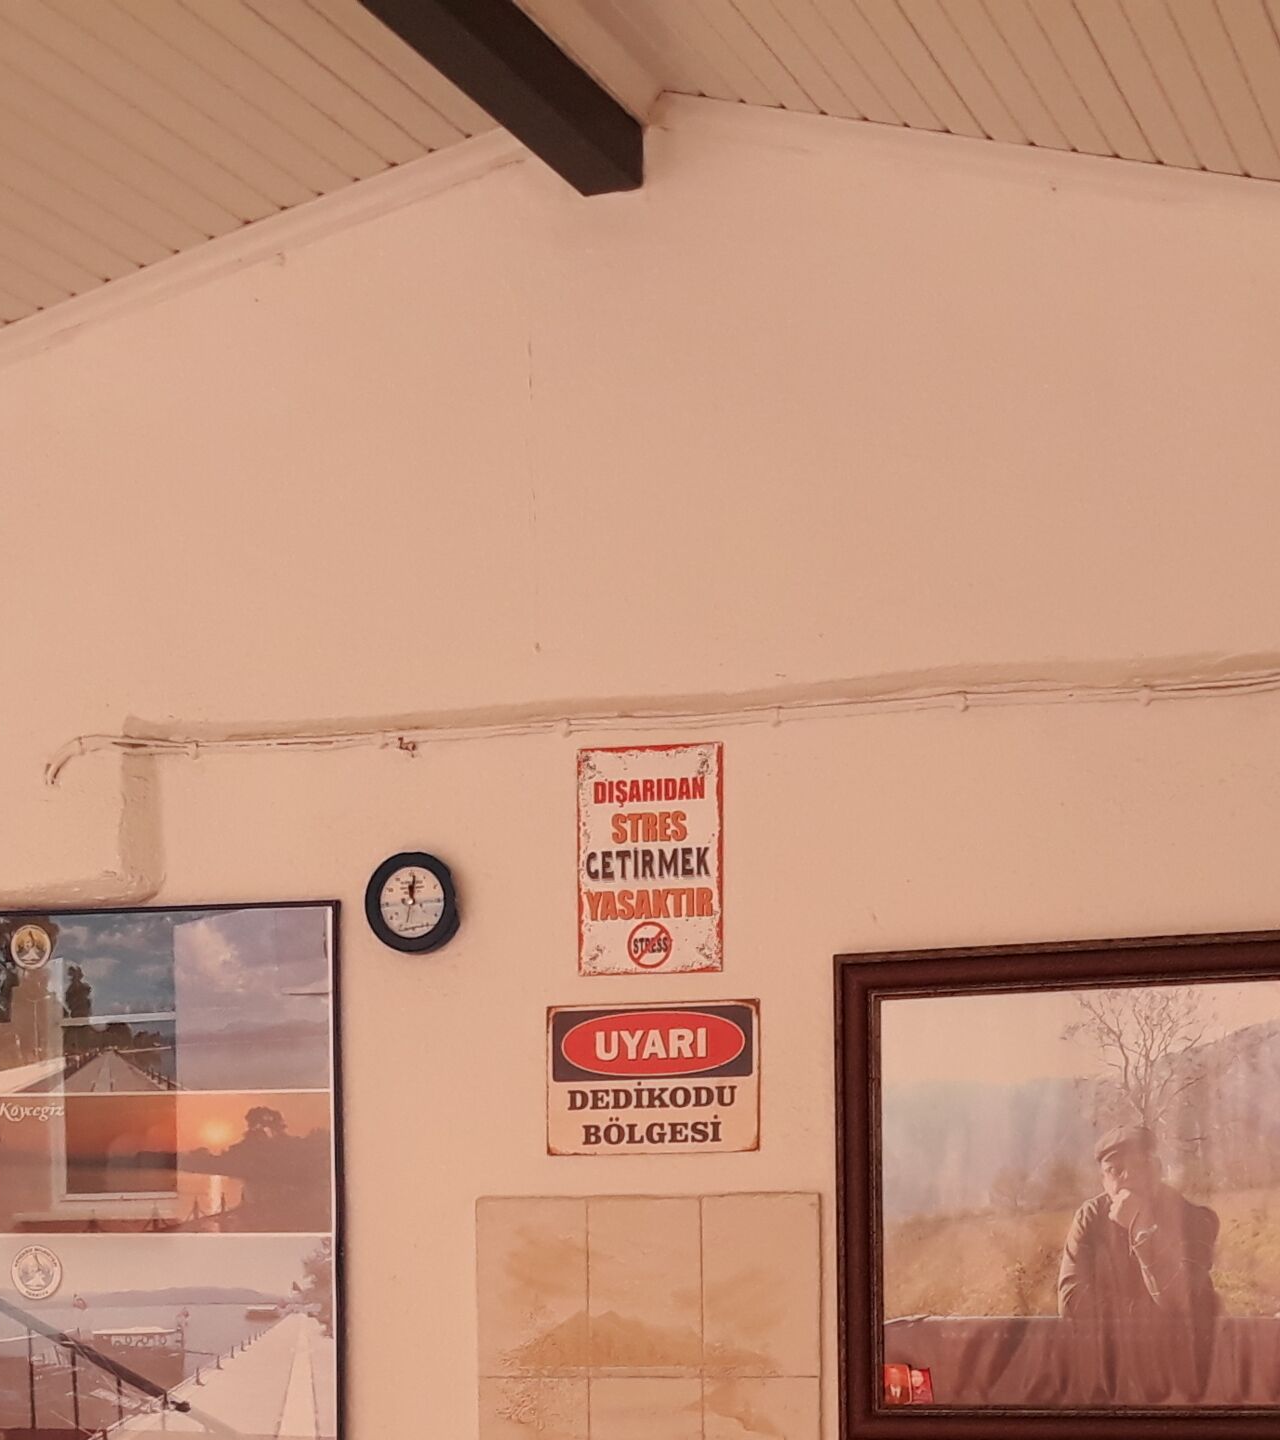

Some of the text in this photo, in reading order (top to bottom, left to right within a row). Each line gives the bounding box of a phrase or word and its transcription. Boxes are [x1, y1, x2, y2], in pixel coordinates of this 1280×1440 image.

[594, 777, 705, 807] DIŞARIDAN
[611, 811, 687, 844] STRES
[585, 888, 713, 921] YASAKTIR
[633, 937, 669, 954] STRESS
[595, 1028, 707, 1061] UYARI
[568, 1081, 738, 1111] DEDİKODU
[582, 1115, 722, 1146] BÖLGESİ
